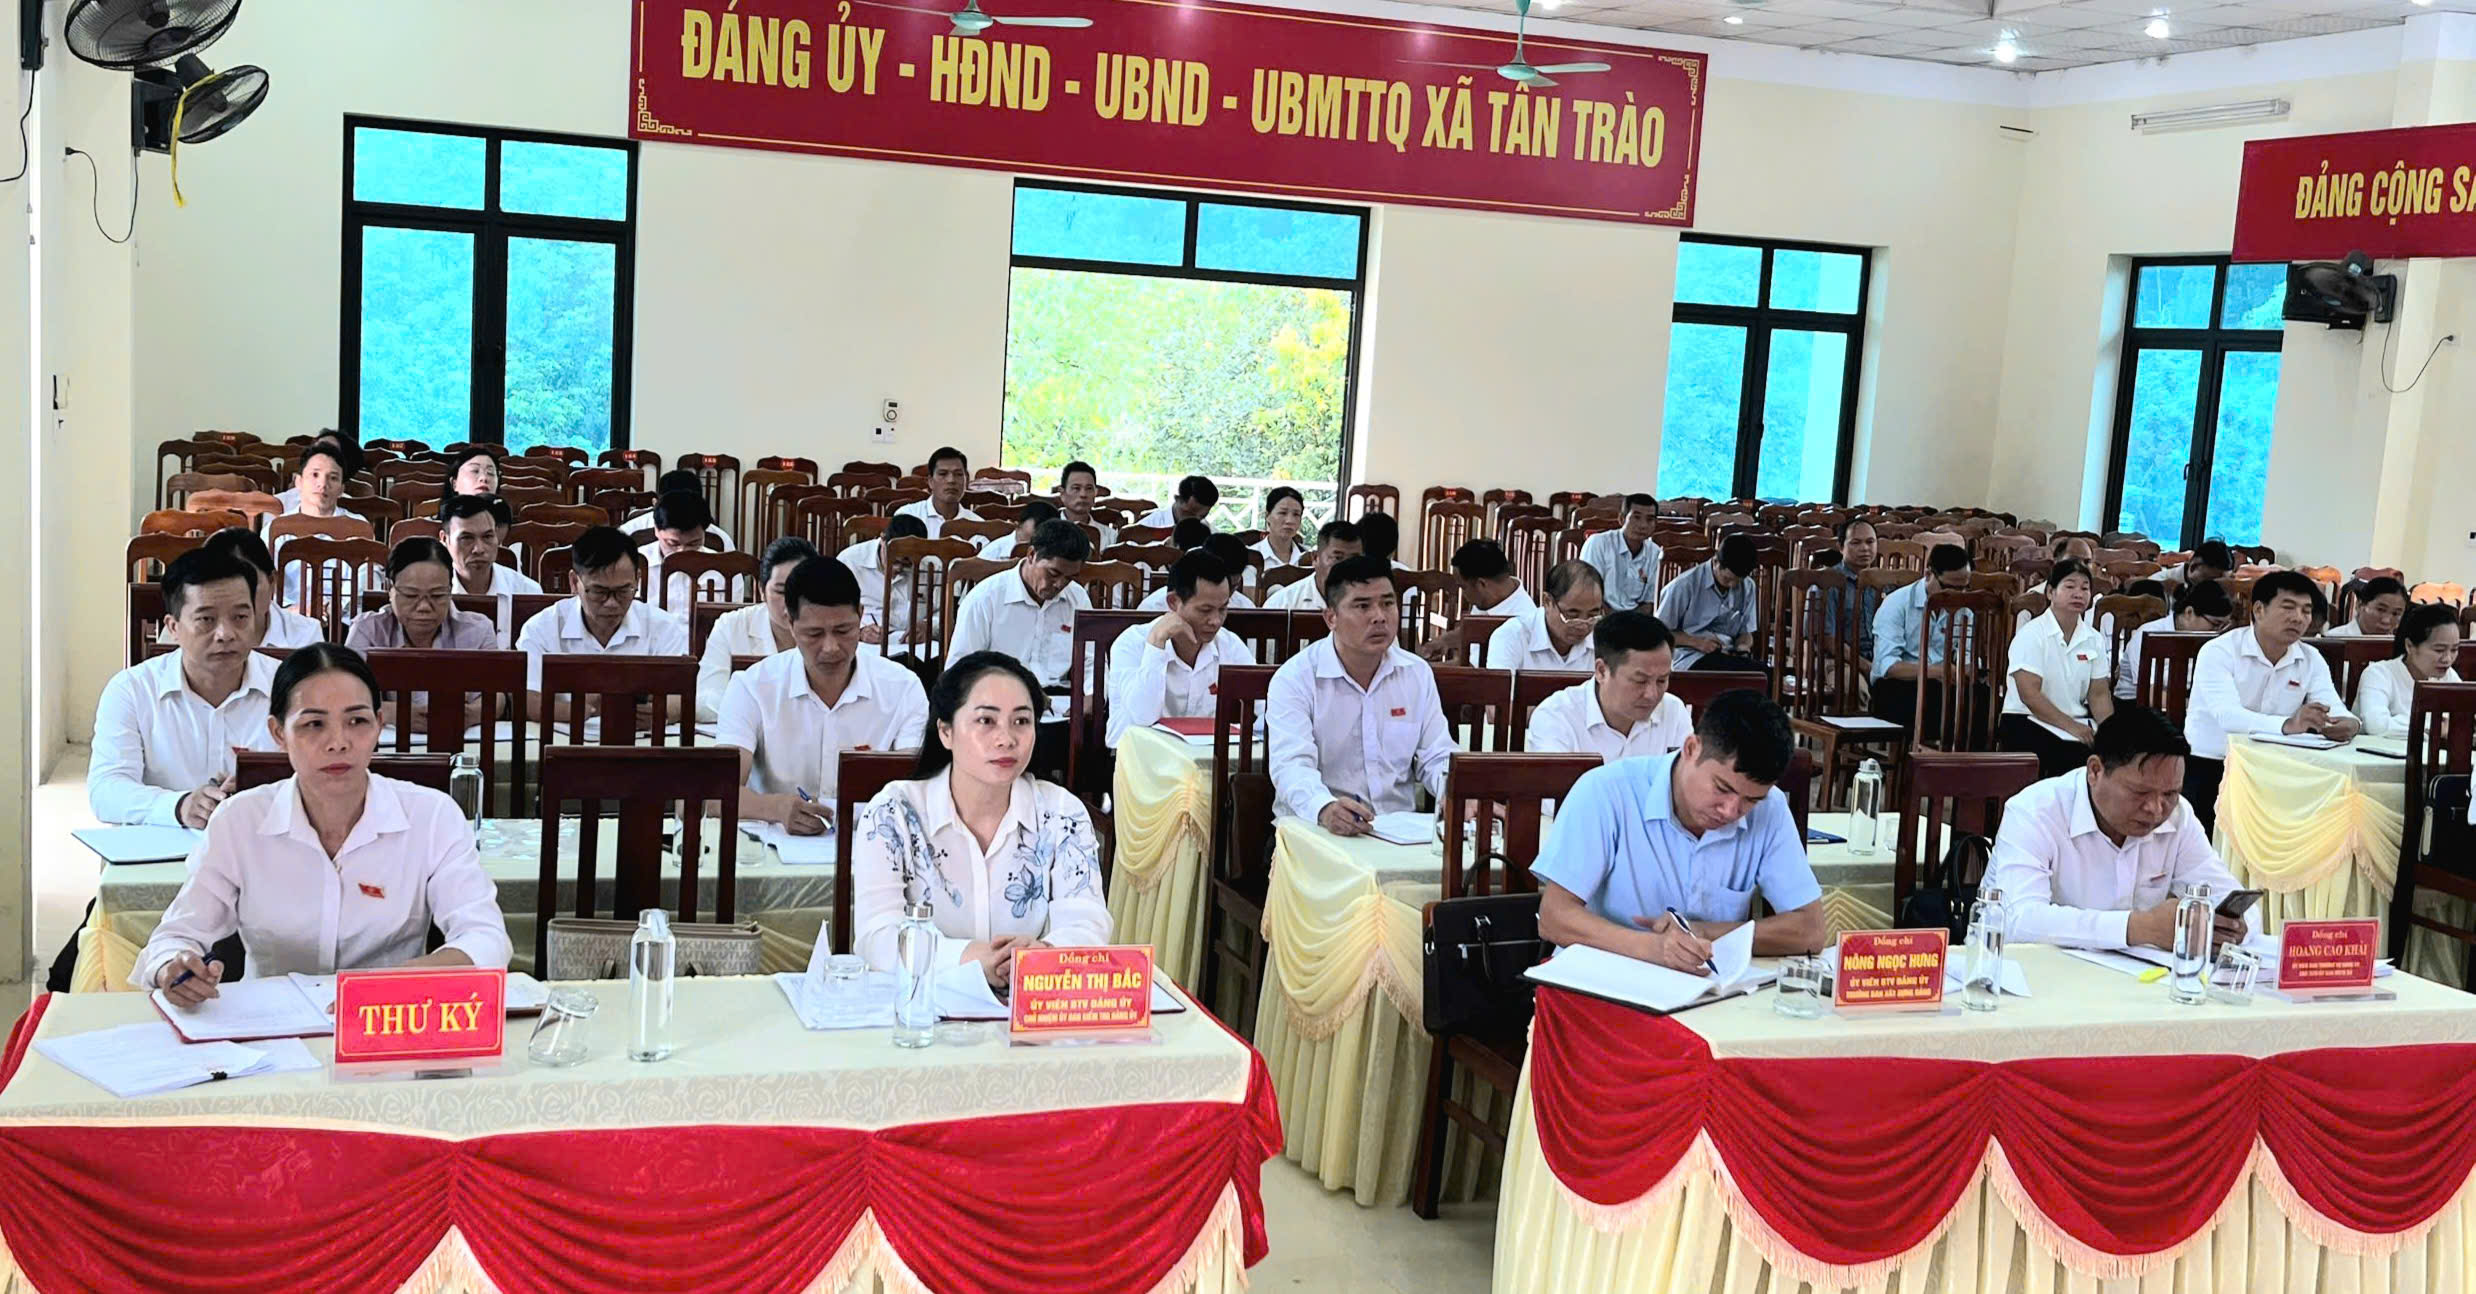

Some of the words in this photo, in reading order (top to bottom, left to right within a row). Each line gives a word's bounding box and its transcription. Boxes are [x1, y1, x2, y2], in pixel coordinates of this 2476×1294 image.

[827, 1, 886, 95] ỦY
[899, 63, 915, 78] -
[929, 35, 1051, 112] HĐND
[1065, 80, 1080, 95] -
[1095, 52, 1210, 127] UBND
[1222, 95, 1238, 110] -
[1251, 68, 1412, 152] UBMTTQ
[1421, 75, 1473, 151] XÃ
[1488, 80, 1561, 158] TÂN
[1573, 91, 1665, 168] TRÀO
[2295, 160, 2364, 219] ĐẢNG
[2370, 160, 2444, 225] CỘNG
[2450, 166, 2476, 213] S
[1087, 972, 1109, 992] THỊ
[359, 998, 433, 1036] THƯ
[438, 992, 483, 1033] KÝ
